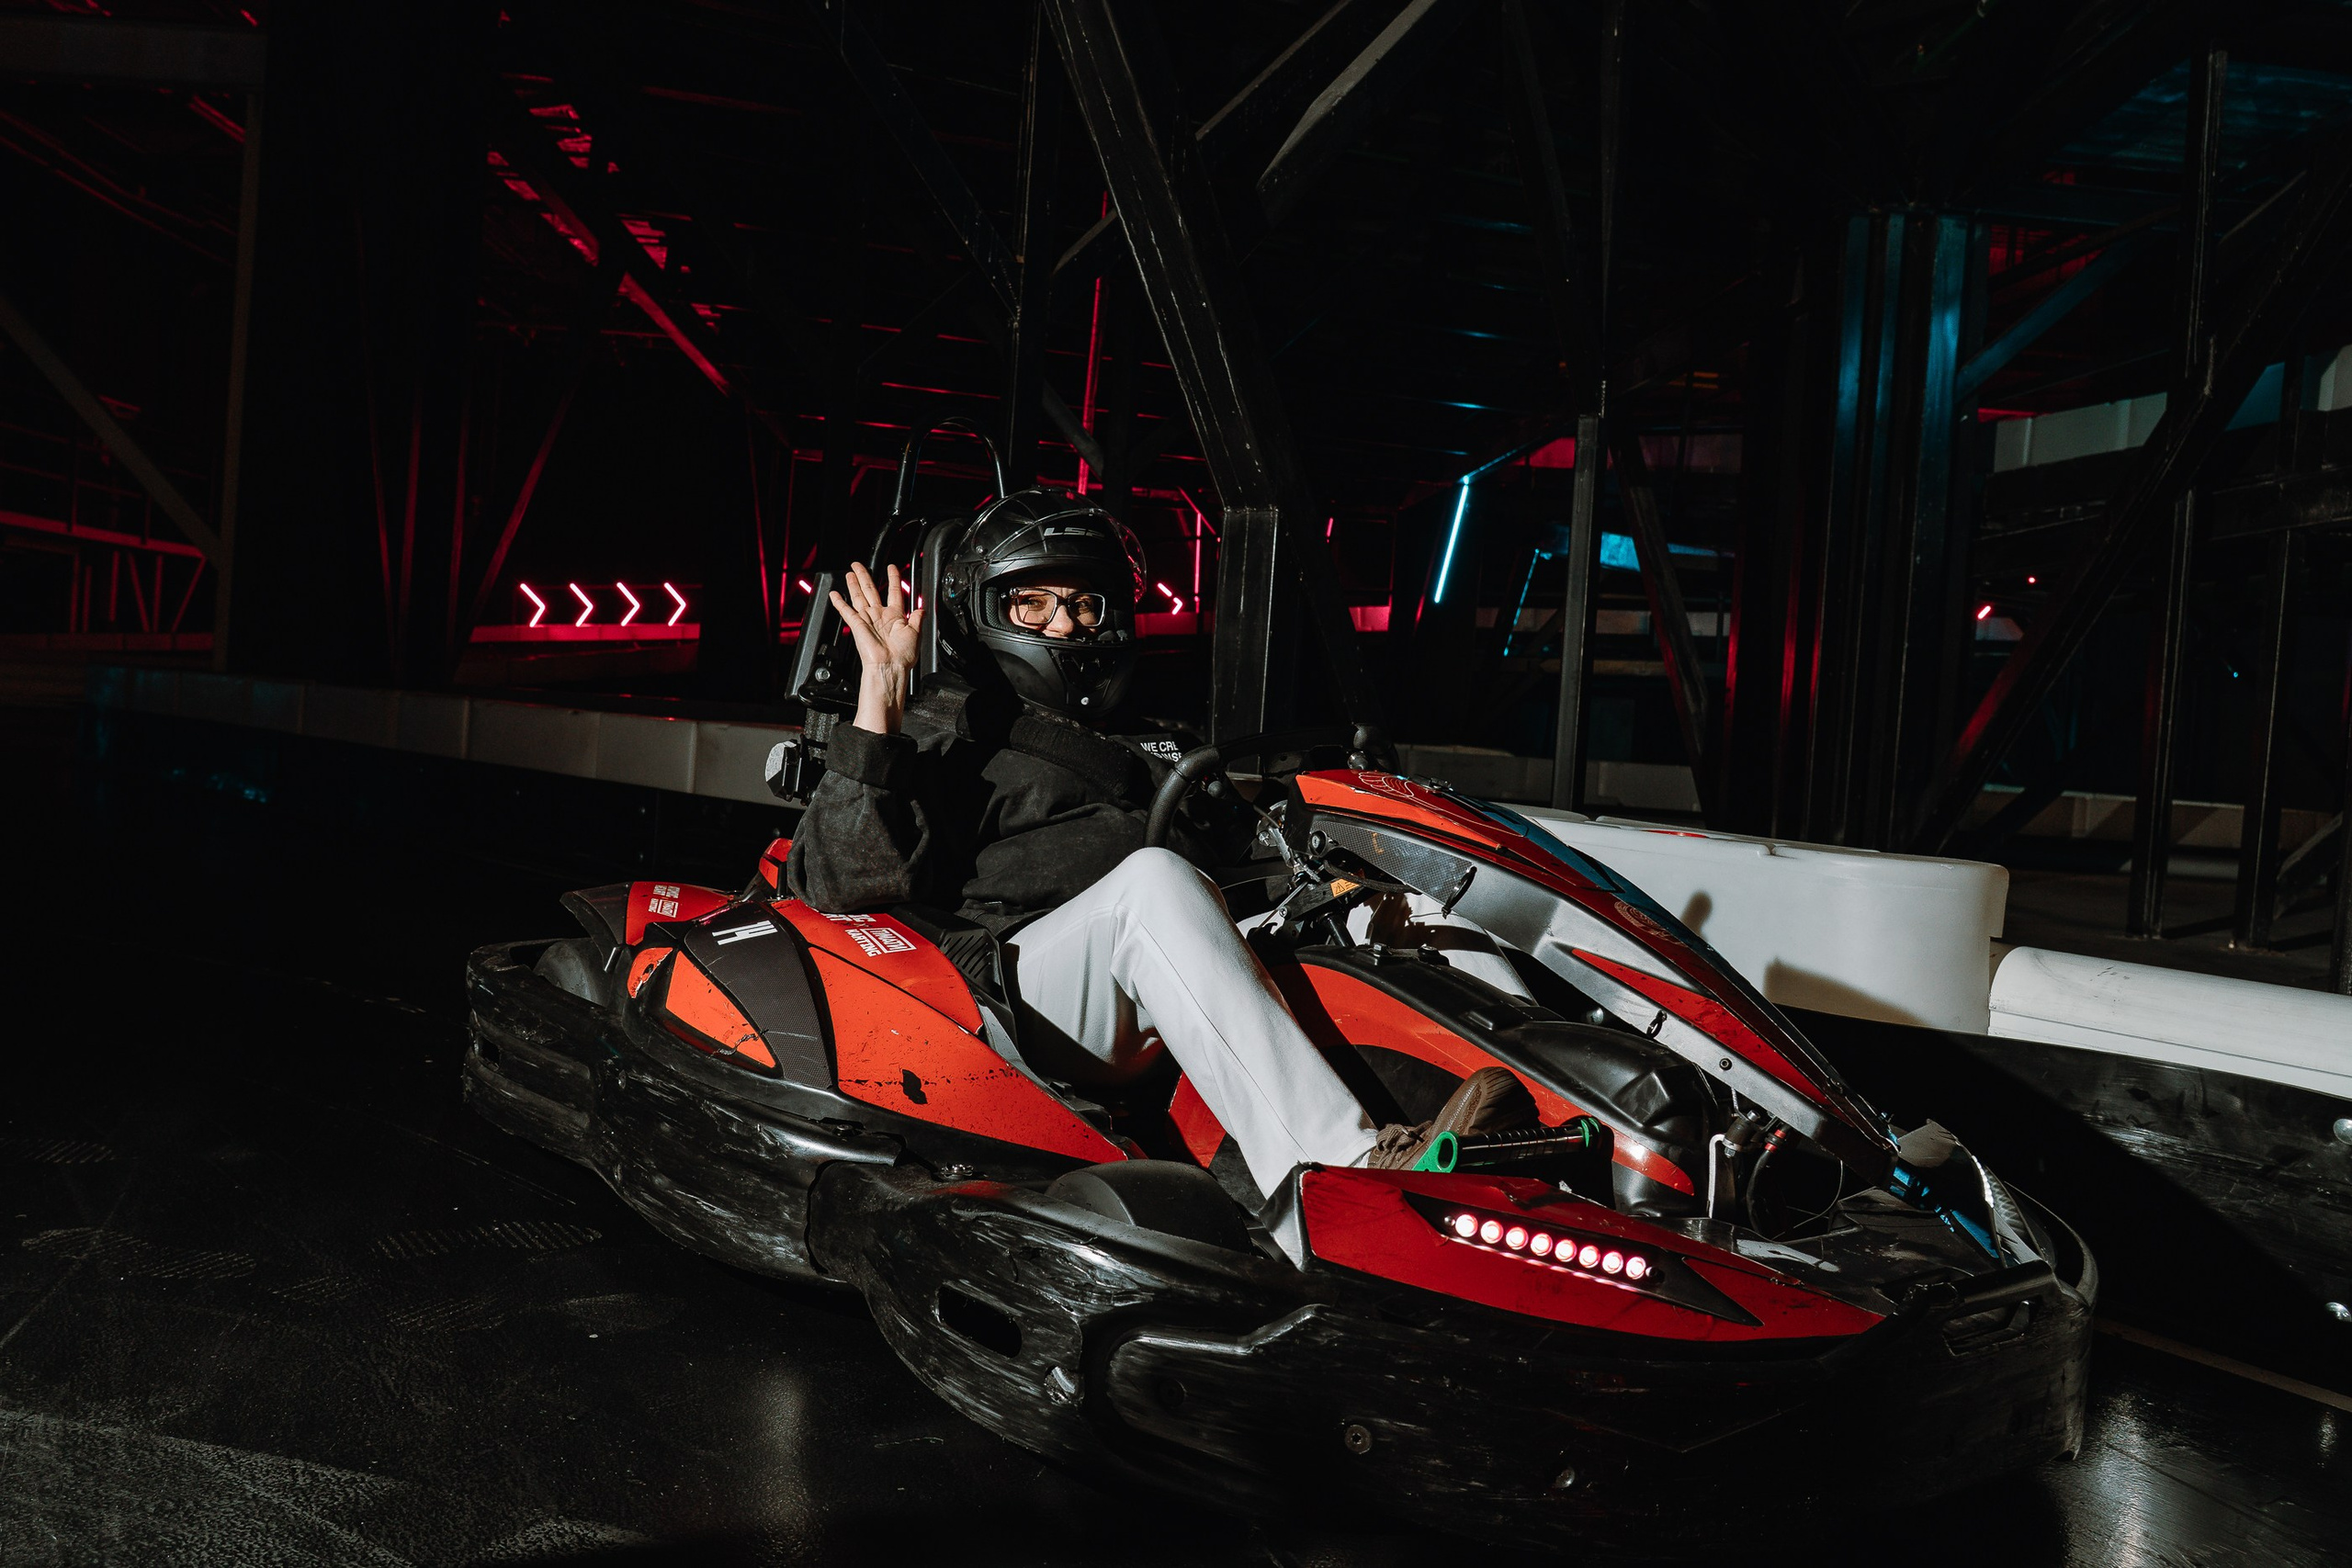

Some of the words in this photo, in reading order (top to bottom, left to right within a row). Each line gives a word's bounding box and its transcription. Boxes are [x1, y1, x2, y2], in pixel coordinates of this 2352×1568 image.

[1043, 526, 1106, 541] LS2
[1139, 741, 1159, 752] WE
[844, 929, 882, 957] KARTING
